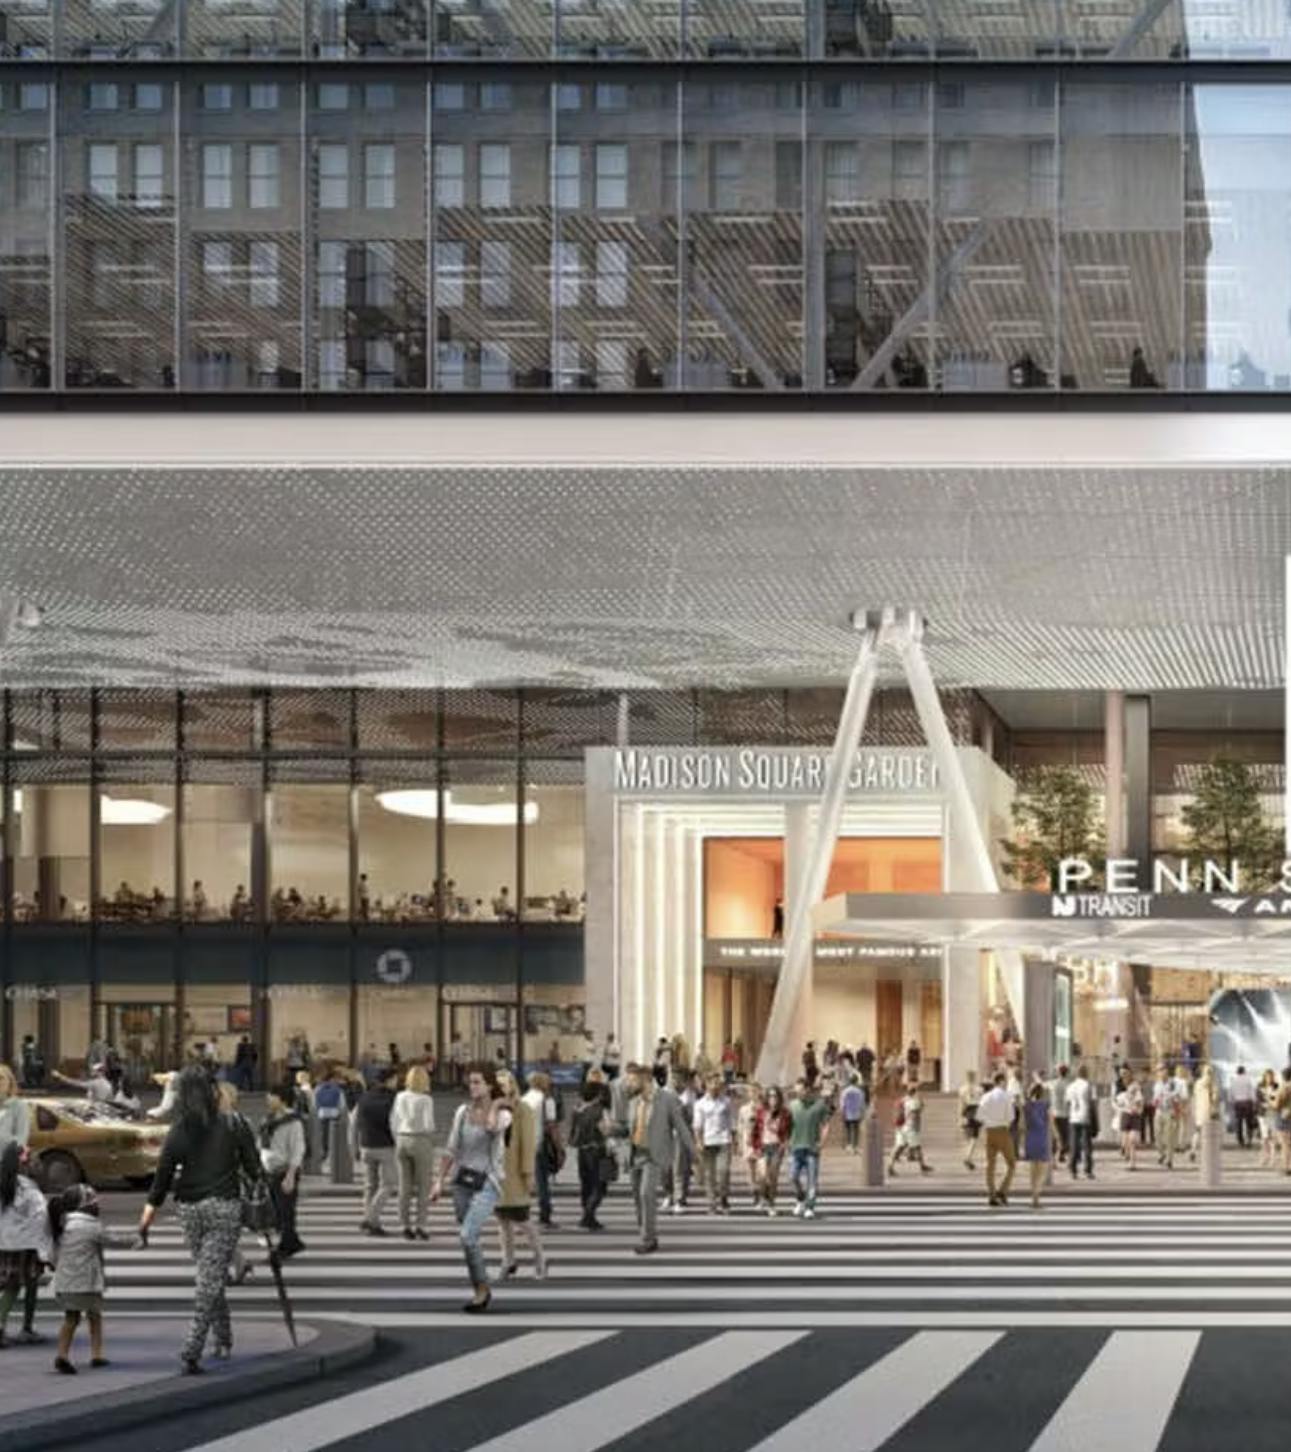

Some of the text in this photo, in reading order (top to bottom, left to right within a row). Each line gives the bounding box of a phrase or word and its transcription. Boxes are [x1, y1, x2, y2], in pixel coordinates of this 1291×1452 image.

[615, 750, 730, 789] MADISON
[738, 750, 832, 789] SQUAR
[1058, 858, 1240, 894] PENN
[1078, 896, 1151, 917] TRANSIT
